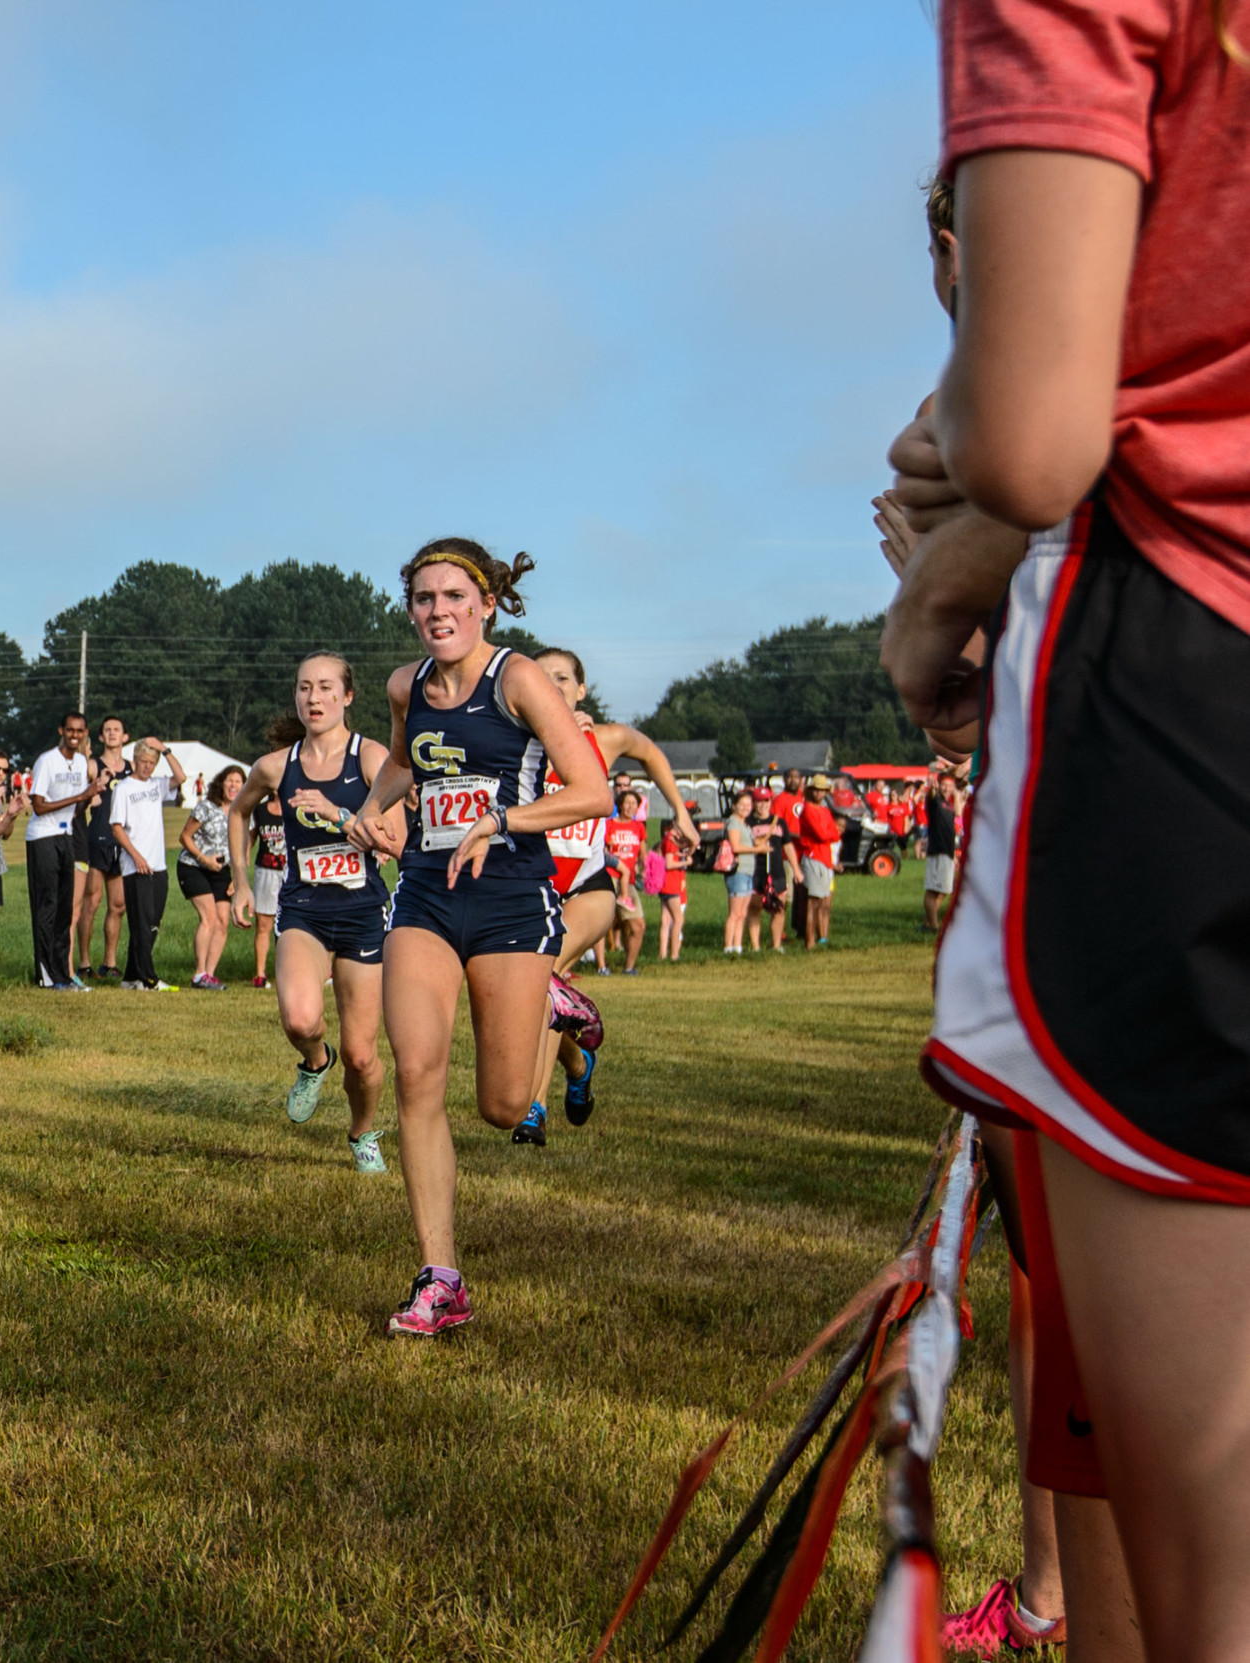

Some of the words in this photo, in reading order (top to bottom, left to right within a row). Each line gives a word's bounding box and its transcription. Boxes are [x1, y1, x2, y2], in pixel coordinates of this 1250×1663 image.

[410, 731, 467, 775] GT
[426, 789, 492, 828] 1228
[305, 851, 361, 881] 1226
